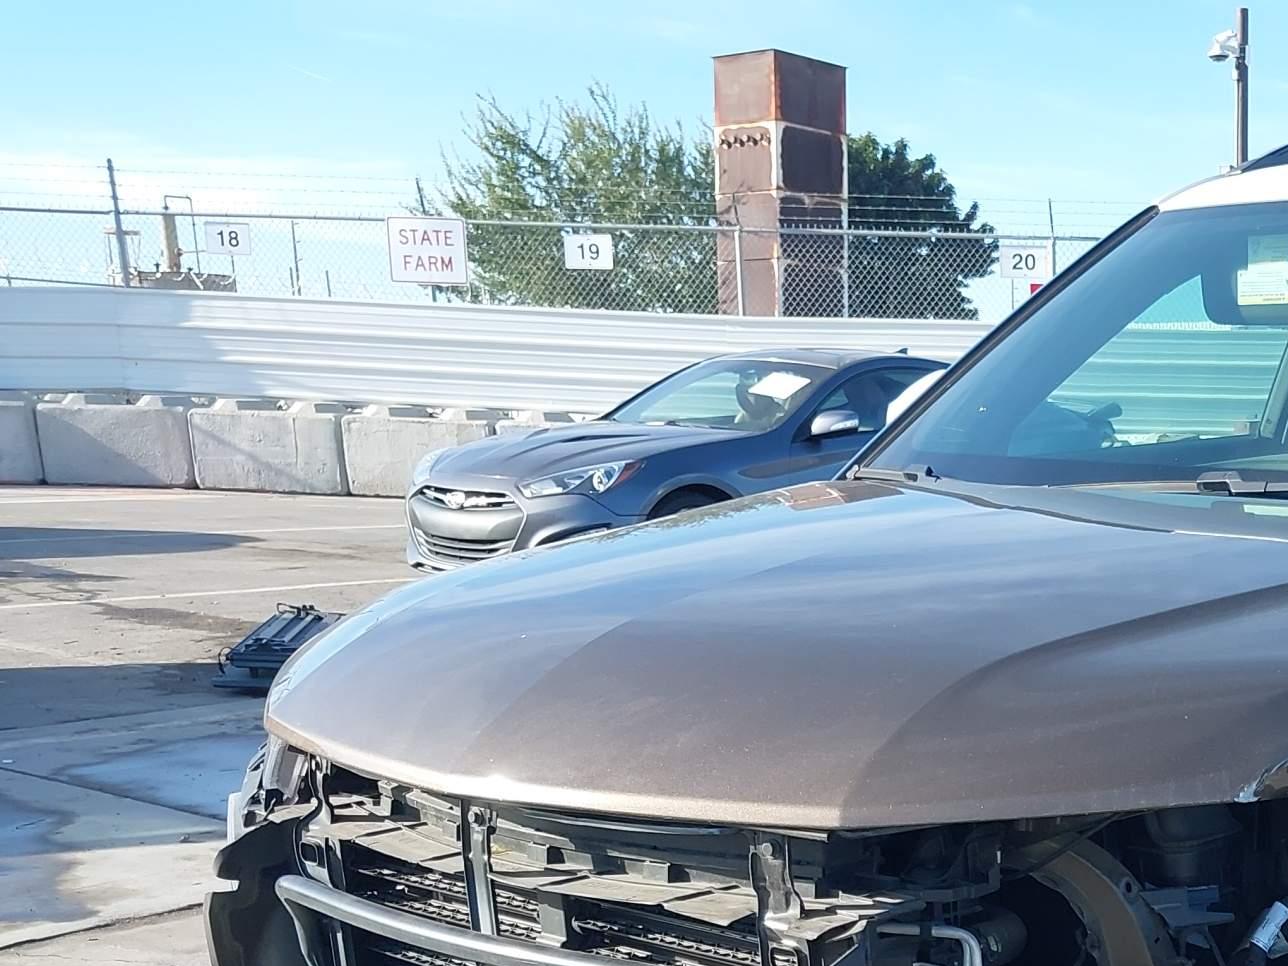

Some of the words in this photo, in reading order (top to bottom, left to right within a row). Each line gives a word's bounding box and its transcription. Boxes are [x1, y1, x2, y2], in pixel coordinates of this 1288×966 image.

[216, 229, 240, 248] 18
[399, 228, 455, 247] STATE
[576, 243, 600, 261] 19
[403, 254, 454, 273] FARM
[1011, 253, 1037, 271] 20
